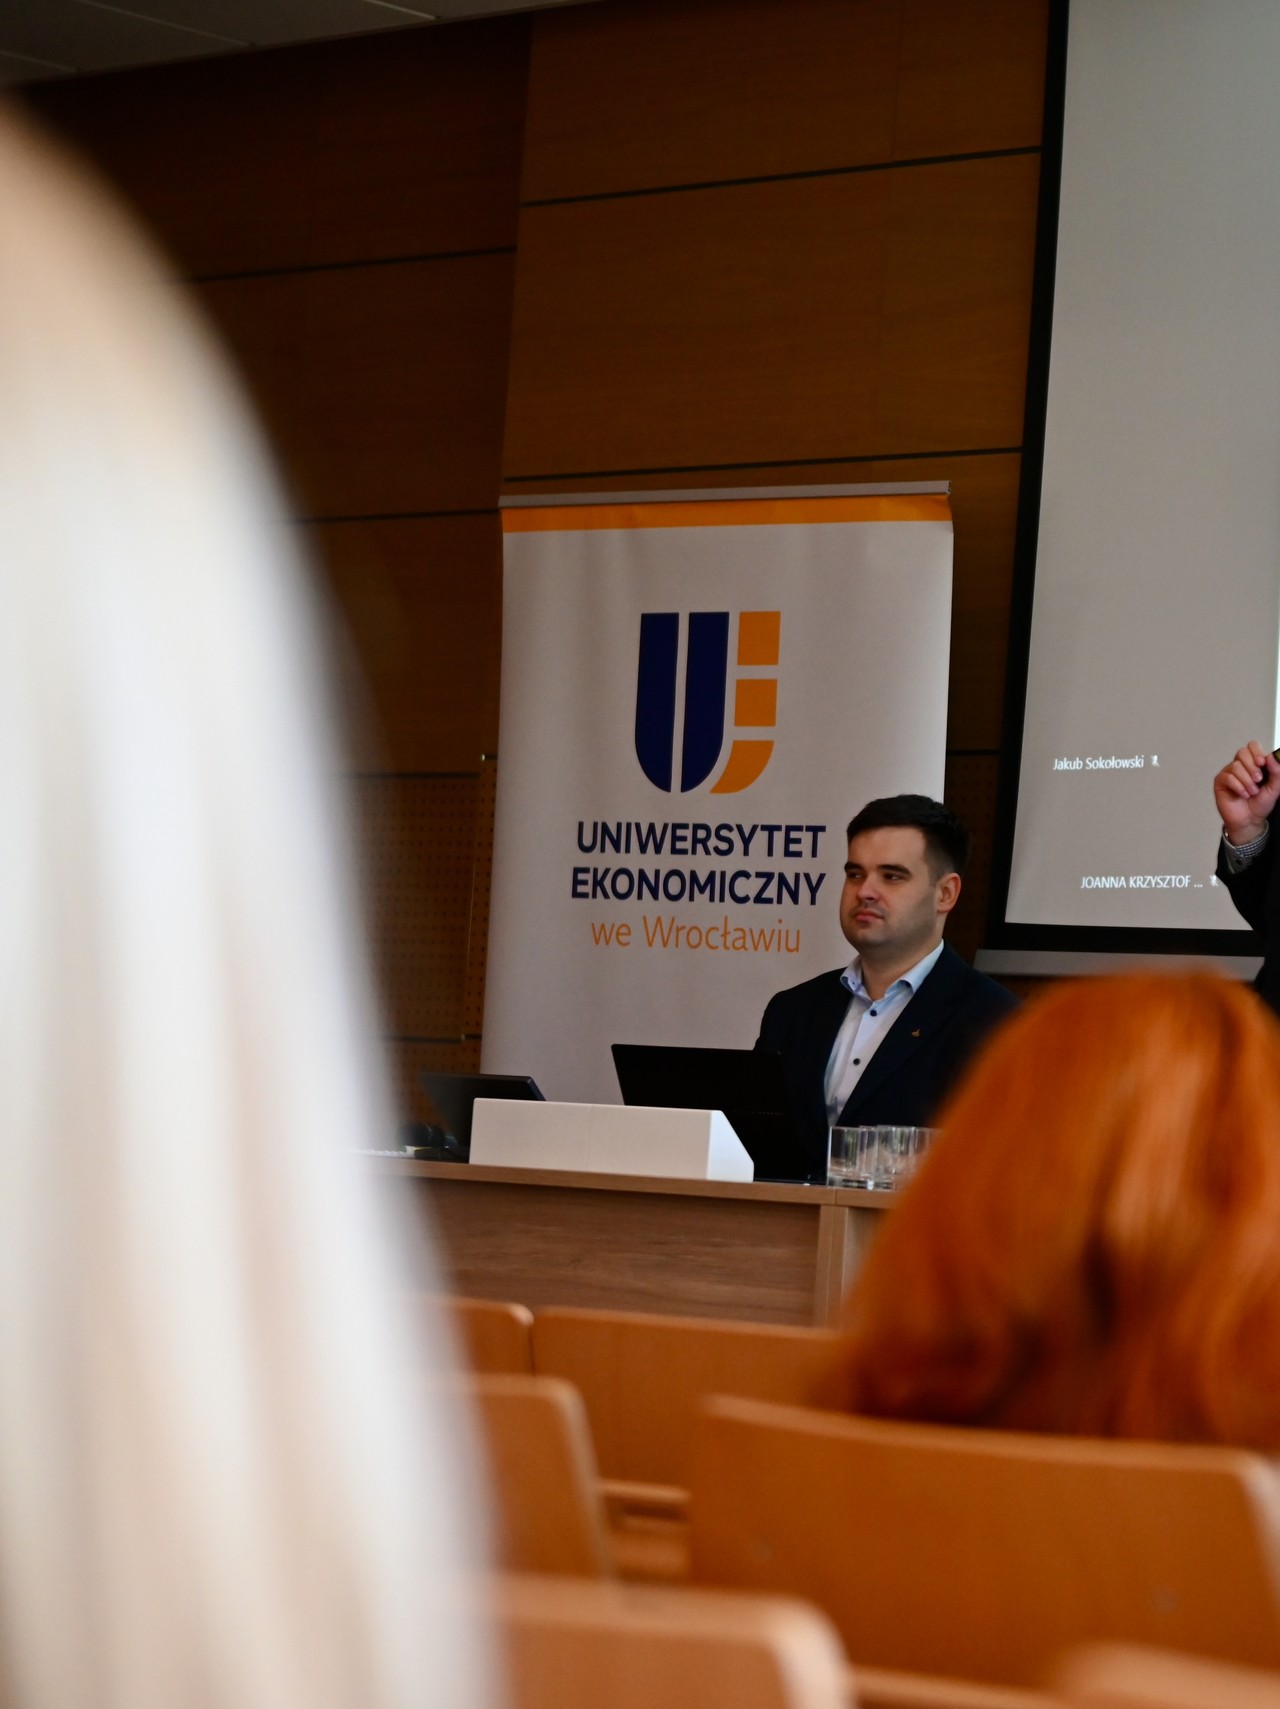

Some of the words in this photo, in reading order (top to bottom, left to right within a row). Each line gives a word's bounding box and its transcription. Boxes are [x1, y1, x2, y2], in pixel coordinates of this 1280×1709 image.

[1053, 757, 1083, 771] Jakub
[1085, 755, 1145, 770] Sokołowski
[576, 820, 826, 859] UNIWERSYTET
[571, 866, 827, 906] EKONOMICZNY
[1080, 875, 1127, 889] JOANNA
[1129, 875, 1191, 889] KRZYSZTOF
[590, 919, 633, 948] we
[641, 914, 801, 954] Wrocławiu
